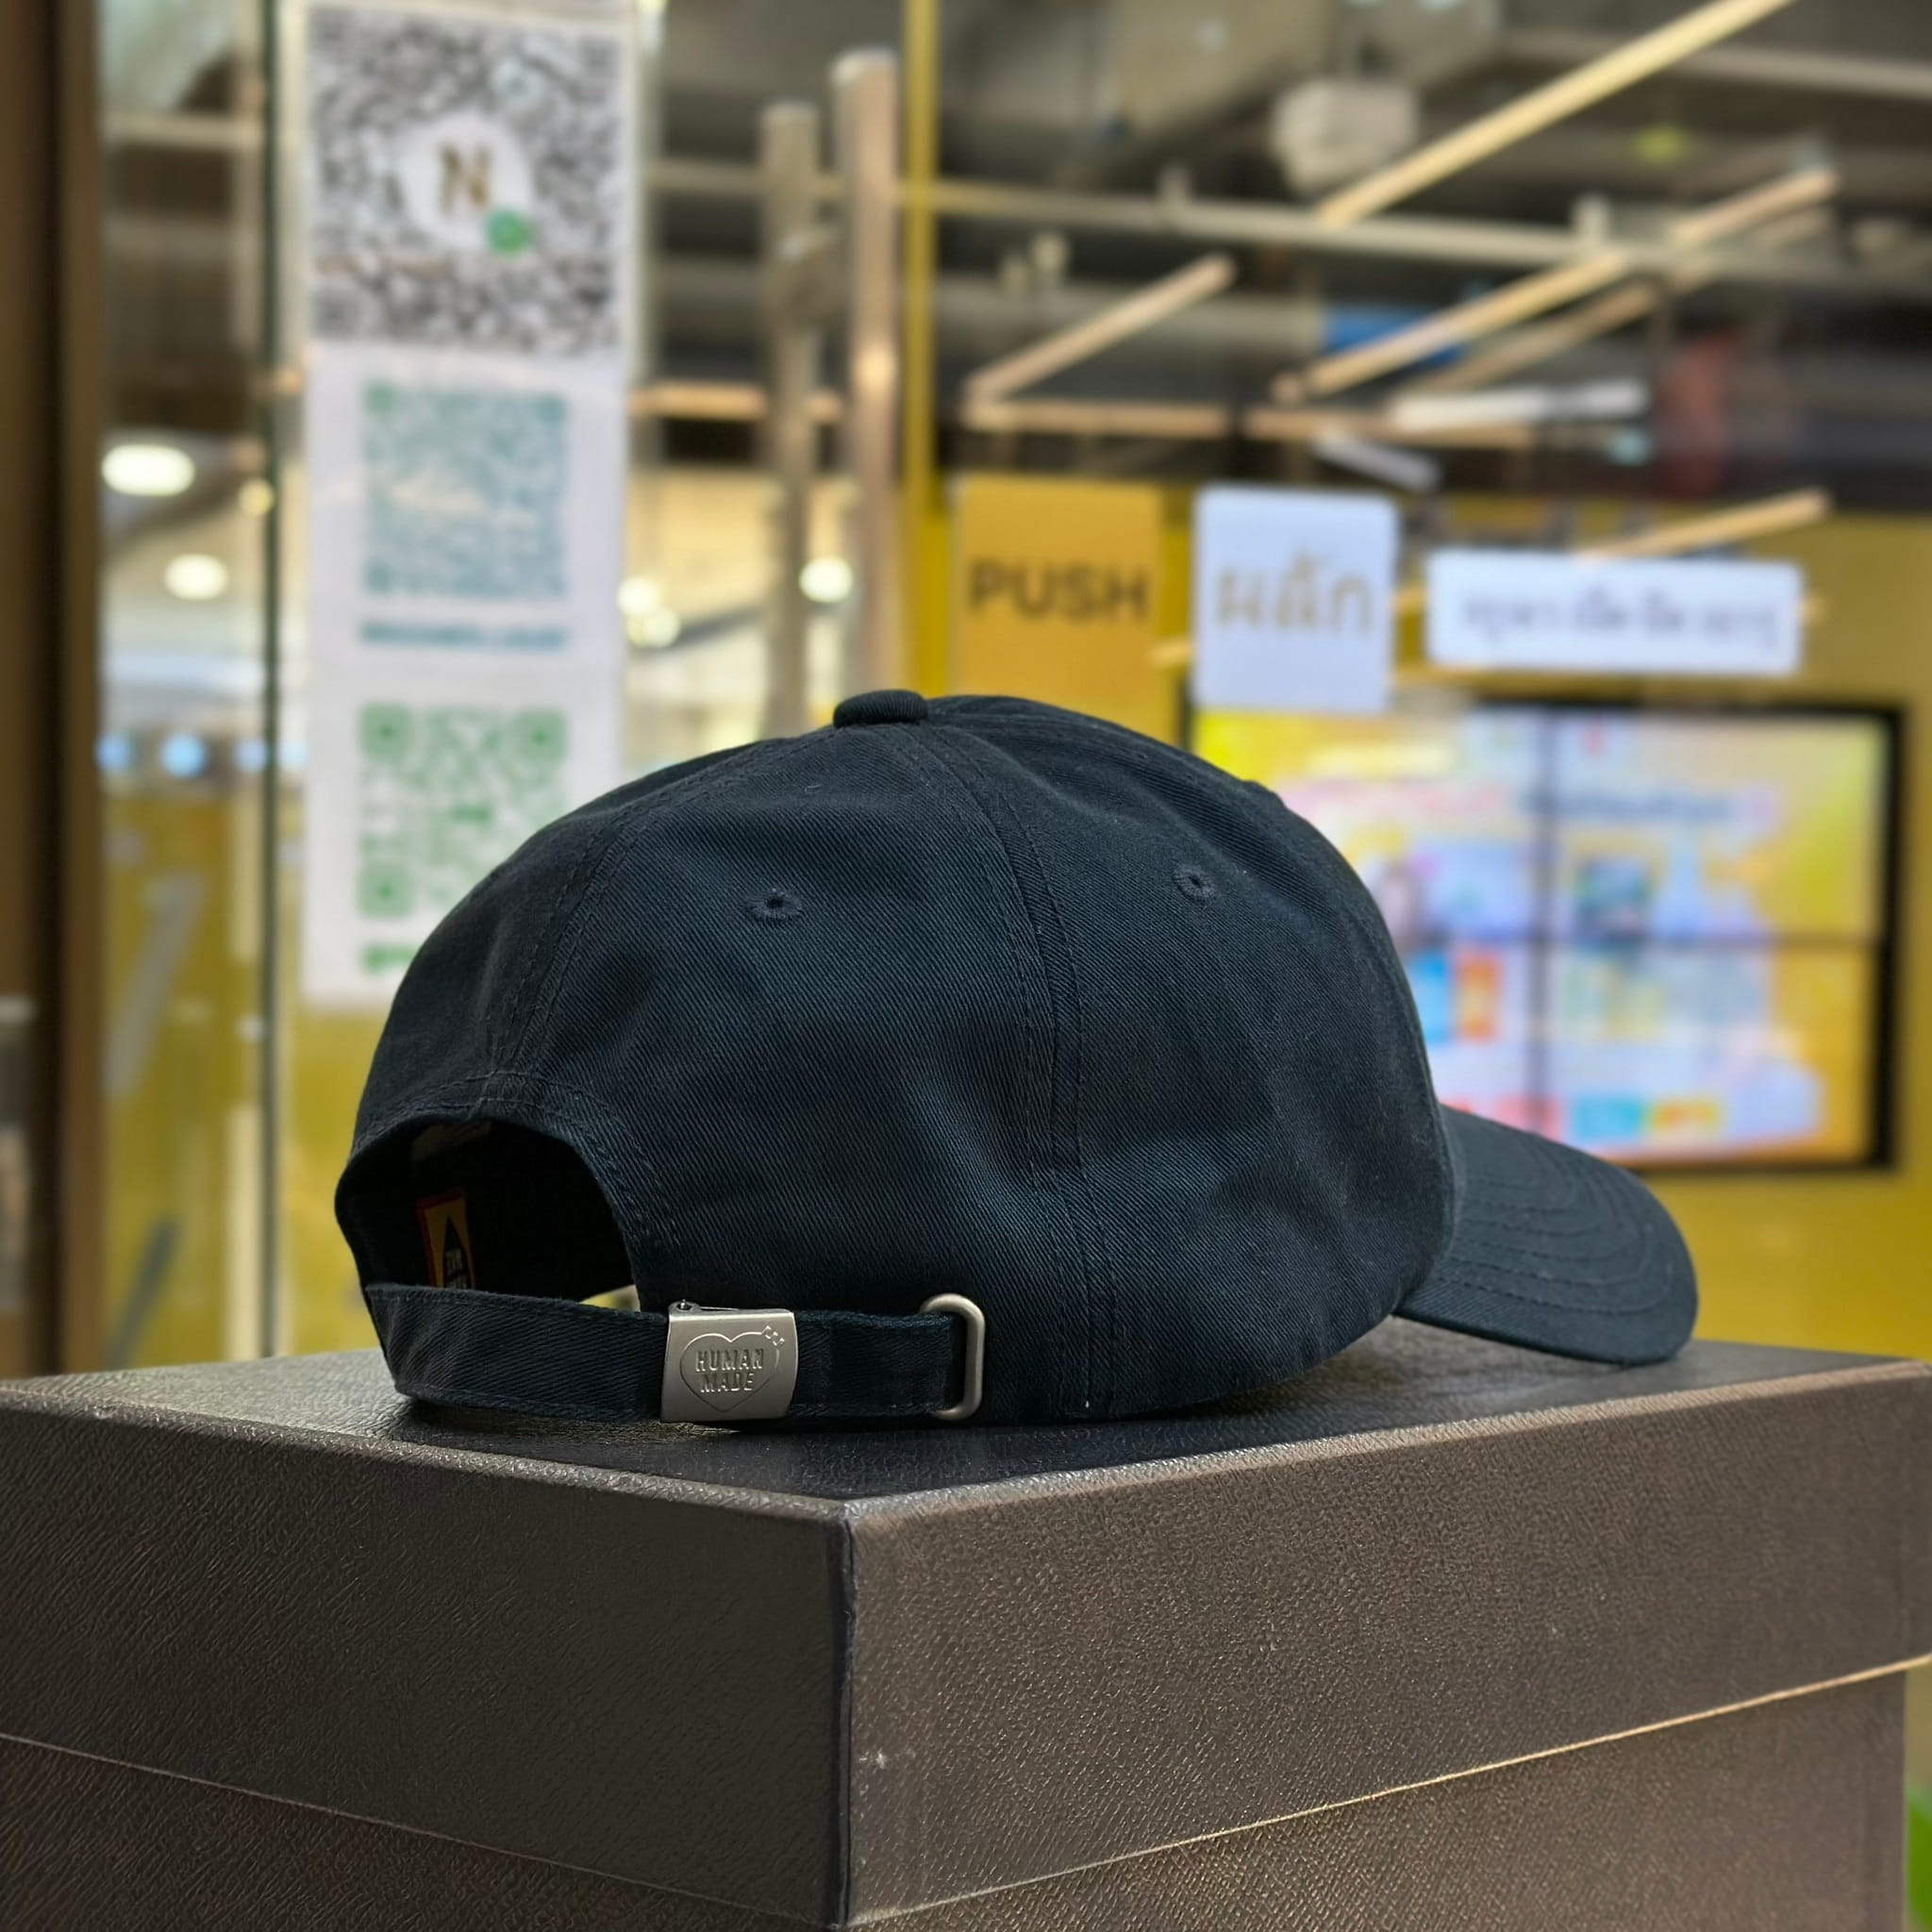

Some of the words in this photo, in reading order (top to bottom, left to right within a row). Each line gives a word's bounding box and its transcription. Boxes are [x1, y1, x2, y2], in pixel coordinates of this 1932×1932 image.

[969, 558, 1148, 625] PUSH
[695, 1348, 765, 1372] HUMAN
[699, 1372, 755, 1393] MADE
